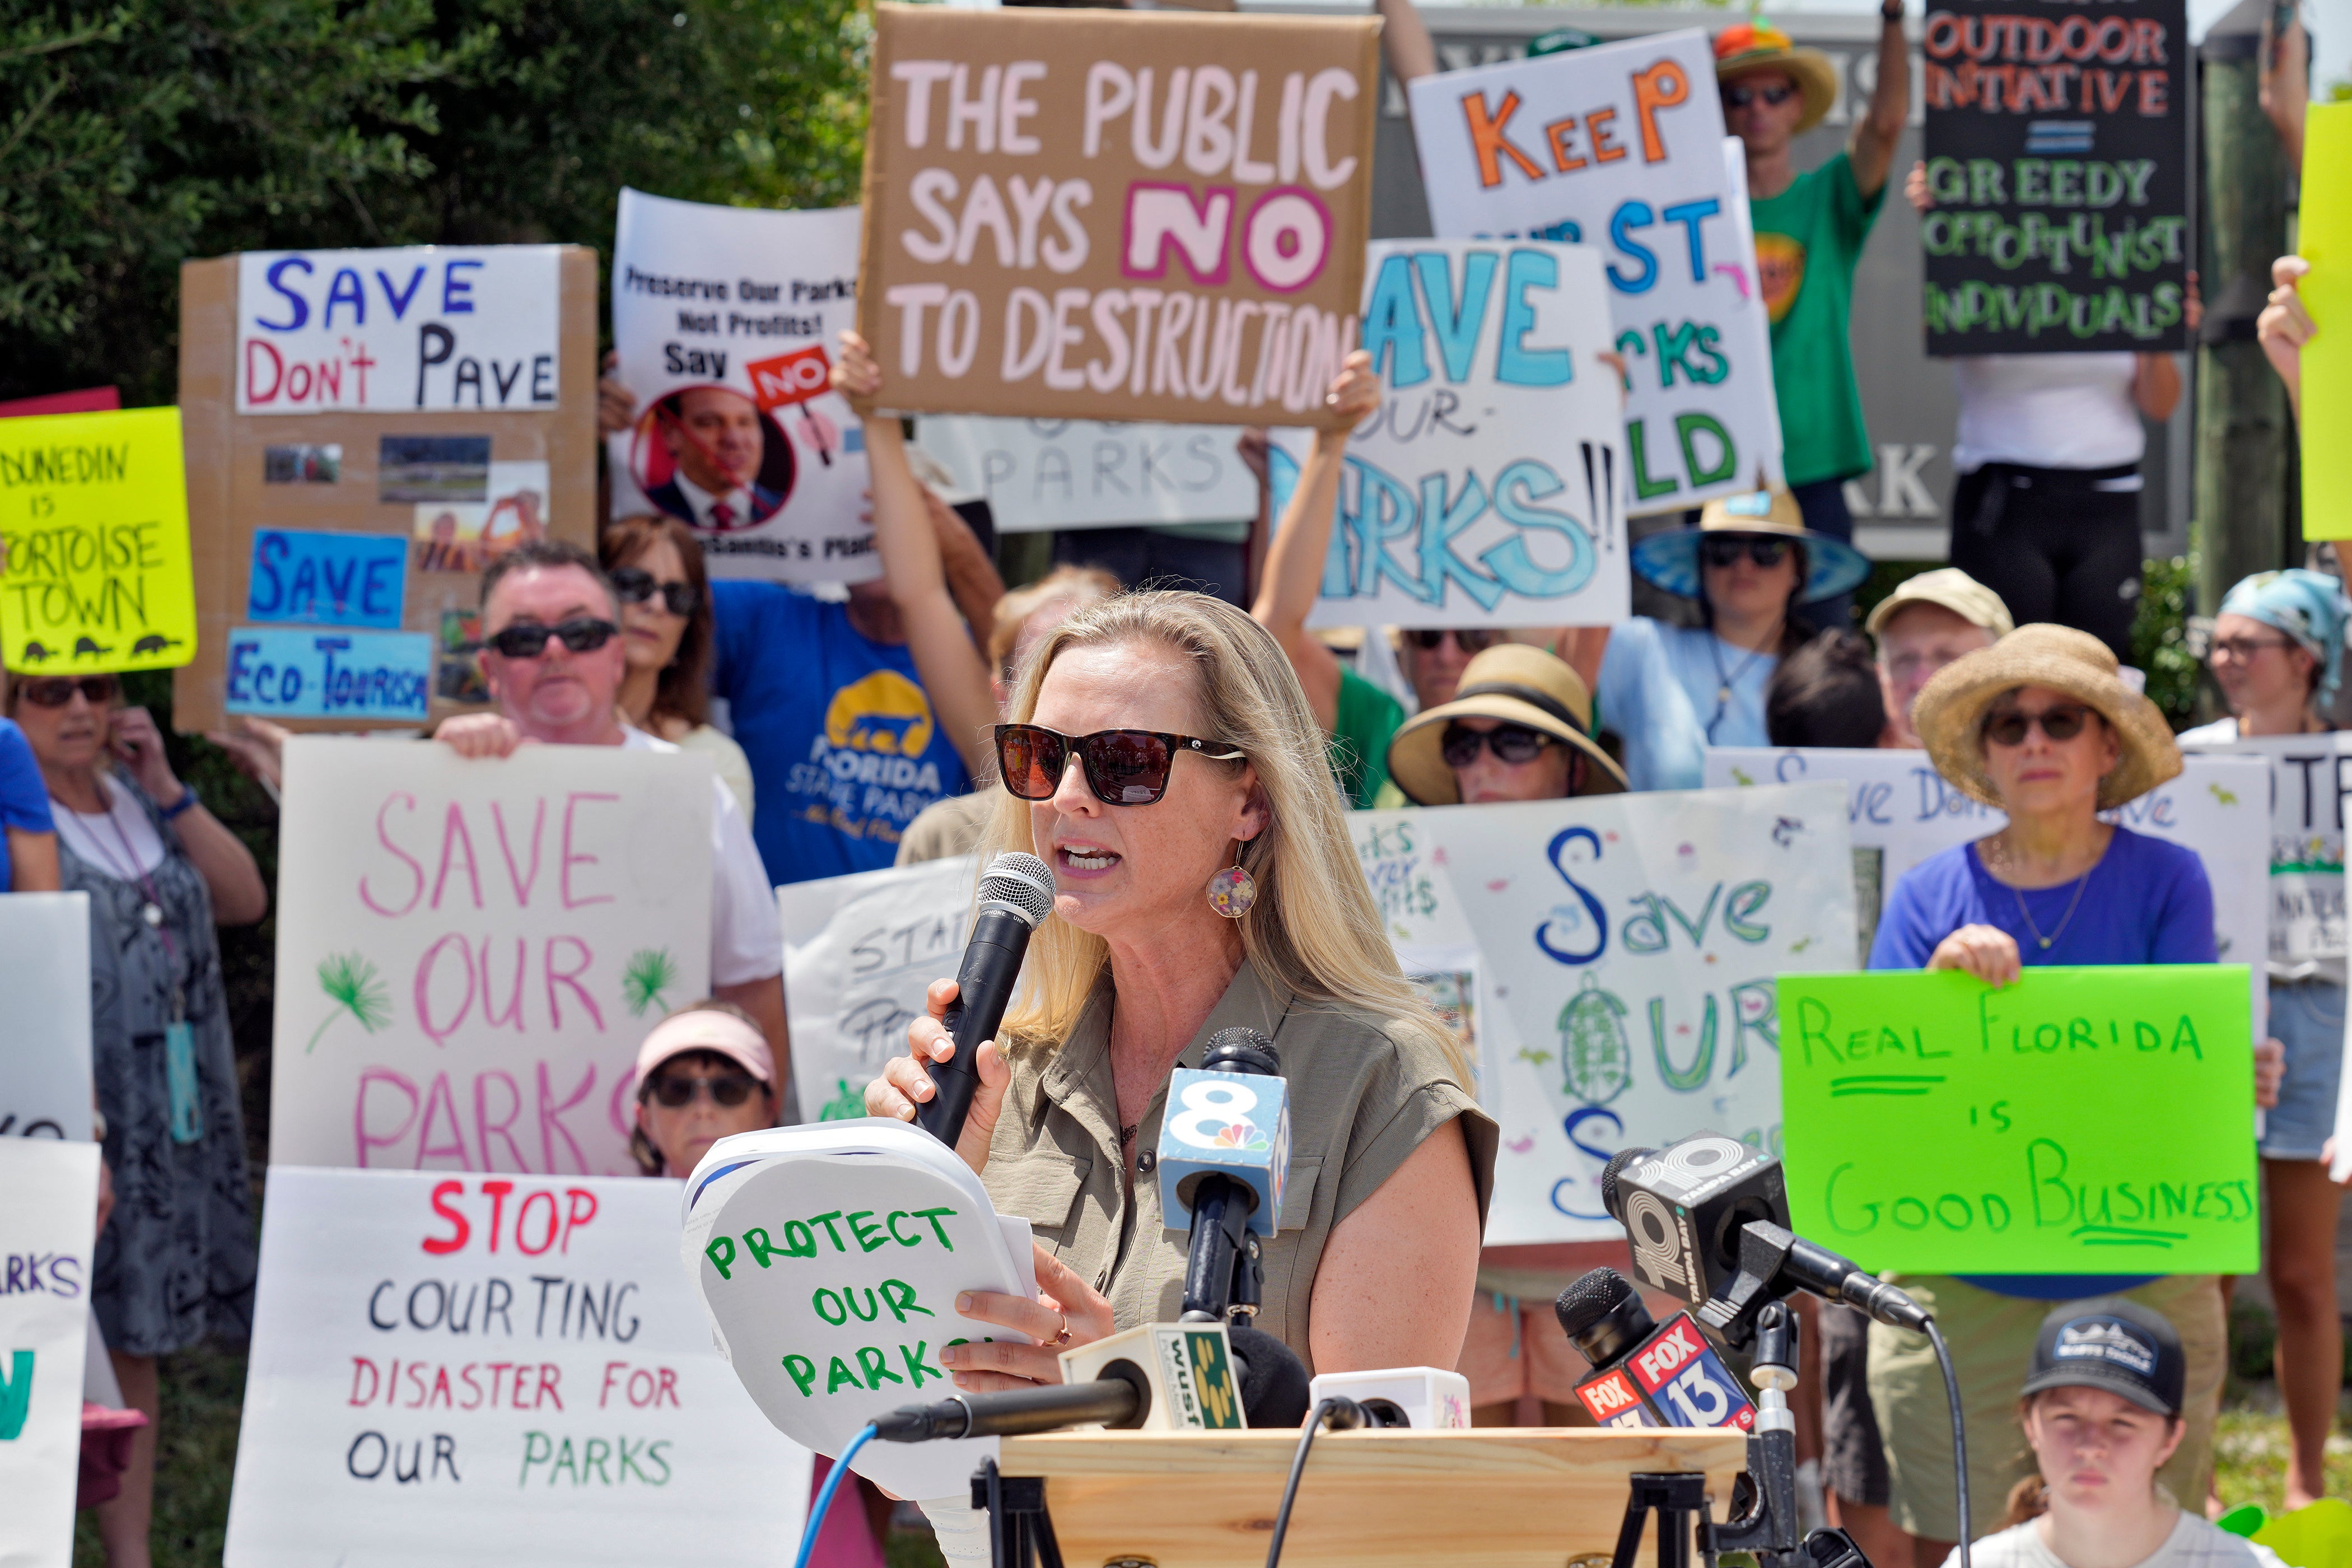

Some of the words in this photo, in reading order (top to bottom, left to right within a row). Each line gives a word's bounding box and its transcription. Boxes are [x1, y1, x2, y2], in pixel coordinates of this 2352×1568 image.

[1925, 10, 2167, 64] OUTDOOR
[892, 60, 1047, 154] THE
[1082, 61, 1359, 190] PUBLIC
[1462, 59, 1690, 188] KEEP
[1925, 155, 2157, 207] GREEDY
[901, 167, 1093, 272] SAYS
[1122, 181, 1333, 293] NO
[1921, 212, 2186, 278] OPPORTUNIST
[255, 257, 485, 331] SAVE
[624, 264, 727, 301] Preserve
[738, 277, 779, 301] Our
[1925, 281, 2182, 339] INDIVIDUALS
[677, 309, 718, 334] Not
[729, 310, 822, 336] Profits!
[886, 283, 980, 379] TO
[1002, 286, 1356, 413] DESTRUCTION
[1362, 249, 1572, 388] AVE
[417, 323, 556, 407] PAVE
[664, 342, 727, 379] Say
[756, 356, 826, 400] NO
[1, 443, 129, 485] DUNEDIN
[982, 433, 1224, 501] PARKS
[30, 494, 55, 517] IS
[5, 575, 148, 632] TOWN
[250, 533, 399, 616] SAVE
[809, 734, 942, 794] FLORIDA
[360, 791, 620, 918] SAVE
[1013, 915, 1025, 925] UHF
[1536, 826, 1772, 965] Save
[414, 932, 606, 1046] OUR
[1798, 995, 1951, 1068] REAL
[1978, 988, 2204, 1061] FLORIDA
[1170, 1080, 1257, 1151] 8
[1678, 1175, 1732, 1201] TAMPA
[1728, 1158, 1758, 1176] BAY
[1825, 1162, 2011, 1236] GOOD
[2026, 1138, 2253, 1228] BUSINESS
[422, 1179, 599, 1257] STOP
[706, 1207, 958, 1280] PROTECT
[1677, 1216, 1691, 1249] BAY
[368, 1276, 640, 1341] COURTING
[812, 1278, 935, 1326] OUR
[1684, 1252, 1700, 1304] TAMPA
[349, 1357, 563, 1411] DISASTER
[600, 1361, 680, 1409] FOR
[1172, 1338, 1201, 1426] wusf
[1639, 1326, 1698, 1384] FOX
[1584, 1376, 1634, 1415] FOX
[1667, 1360, 1728, 1427] 13
[347, 1430, 461, 1483] OUR
[518, 1430, 672, 1489] PARKS
